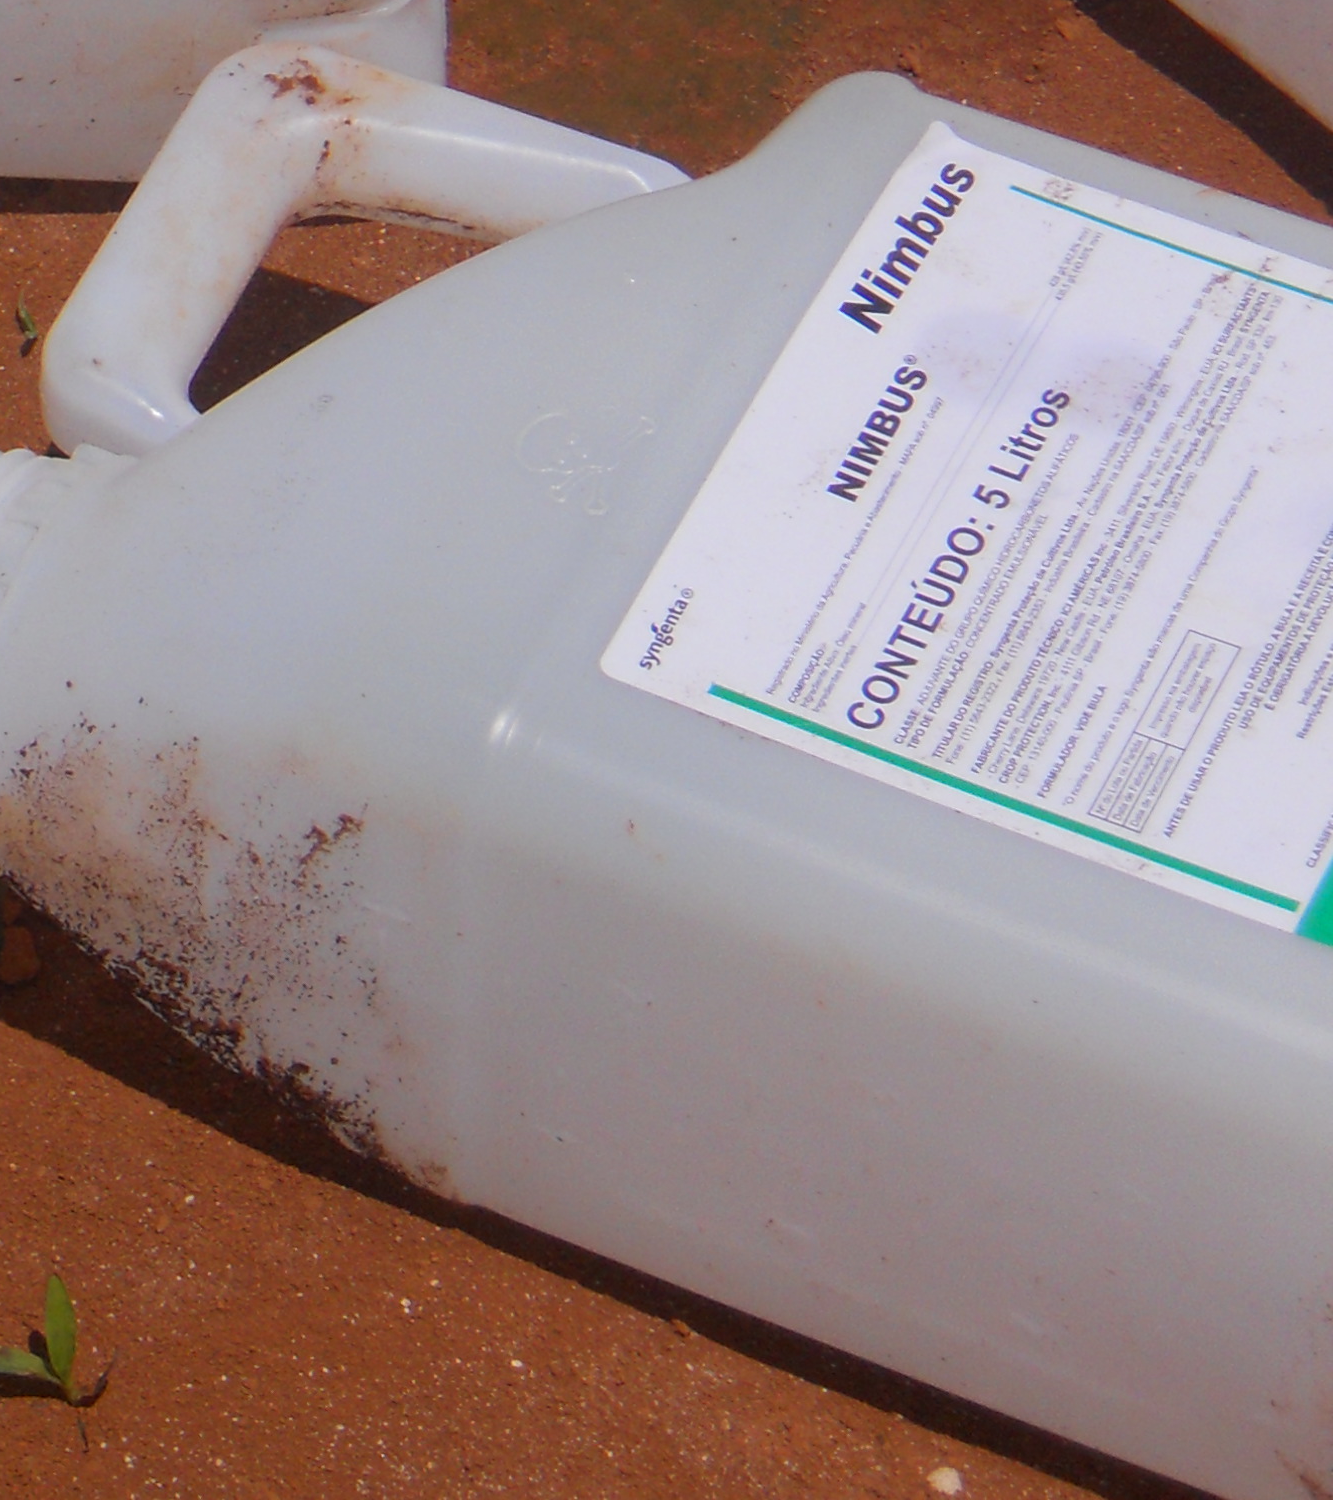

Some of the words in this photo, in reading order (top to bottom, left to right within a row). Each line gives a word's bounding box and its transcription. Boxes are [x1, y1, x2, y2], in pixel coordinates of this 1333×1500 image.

[837, 161, 977, 334] Nimbus
[971, 483, 1012, 510] 5
[987, 387, 1072, 483] Litros
[841, 515, 996, 731] CONTEÚDO:
